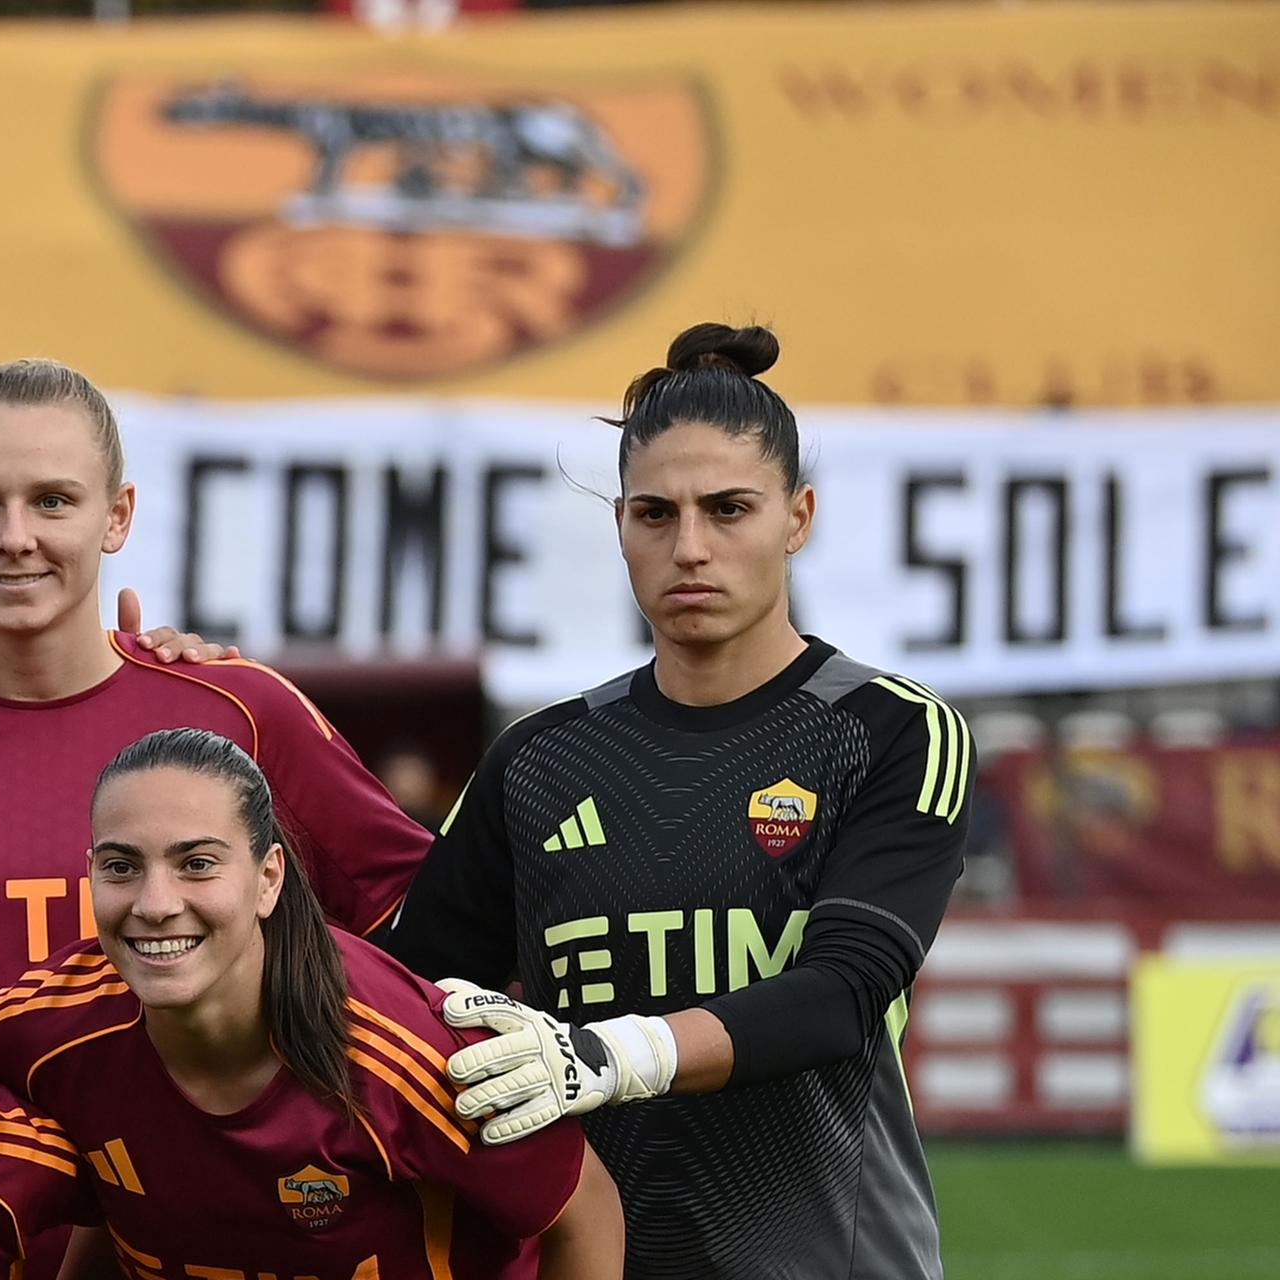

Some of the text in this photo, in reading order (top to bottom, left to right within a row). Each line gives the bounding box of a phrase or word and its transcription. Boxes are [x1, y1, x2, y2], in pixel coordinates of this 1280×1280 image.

[180, 454, 550, 647] COME
[900, 465, 1271, 652] SOLE
[756, 822, 801, 838] ROMA
[766, 838, 786, 848] 1927
[292, 1203, 344, 1220] ROMA
